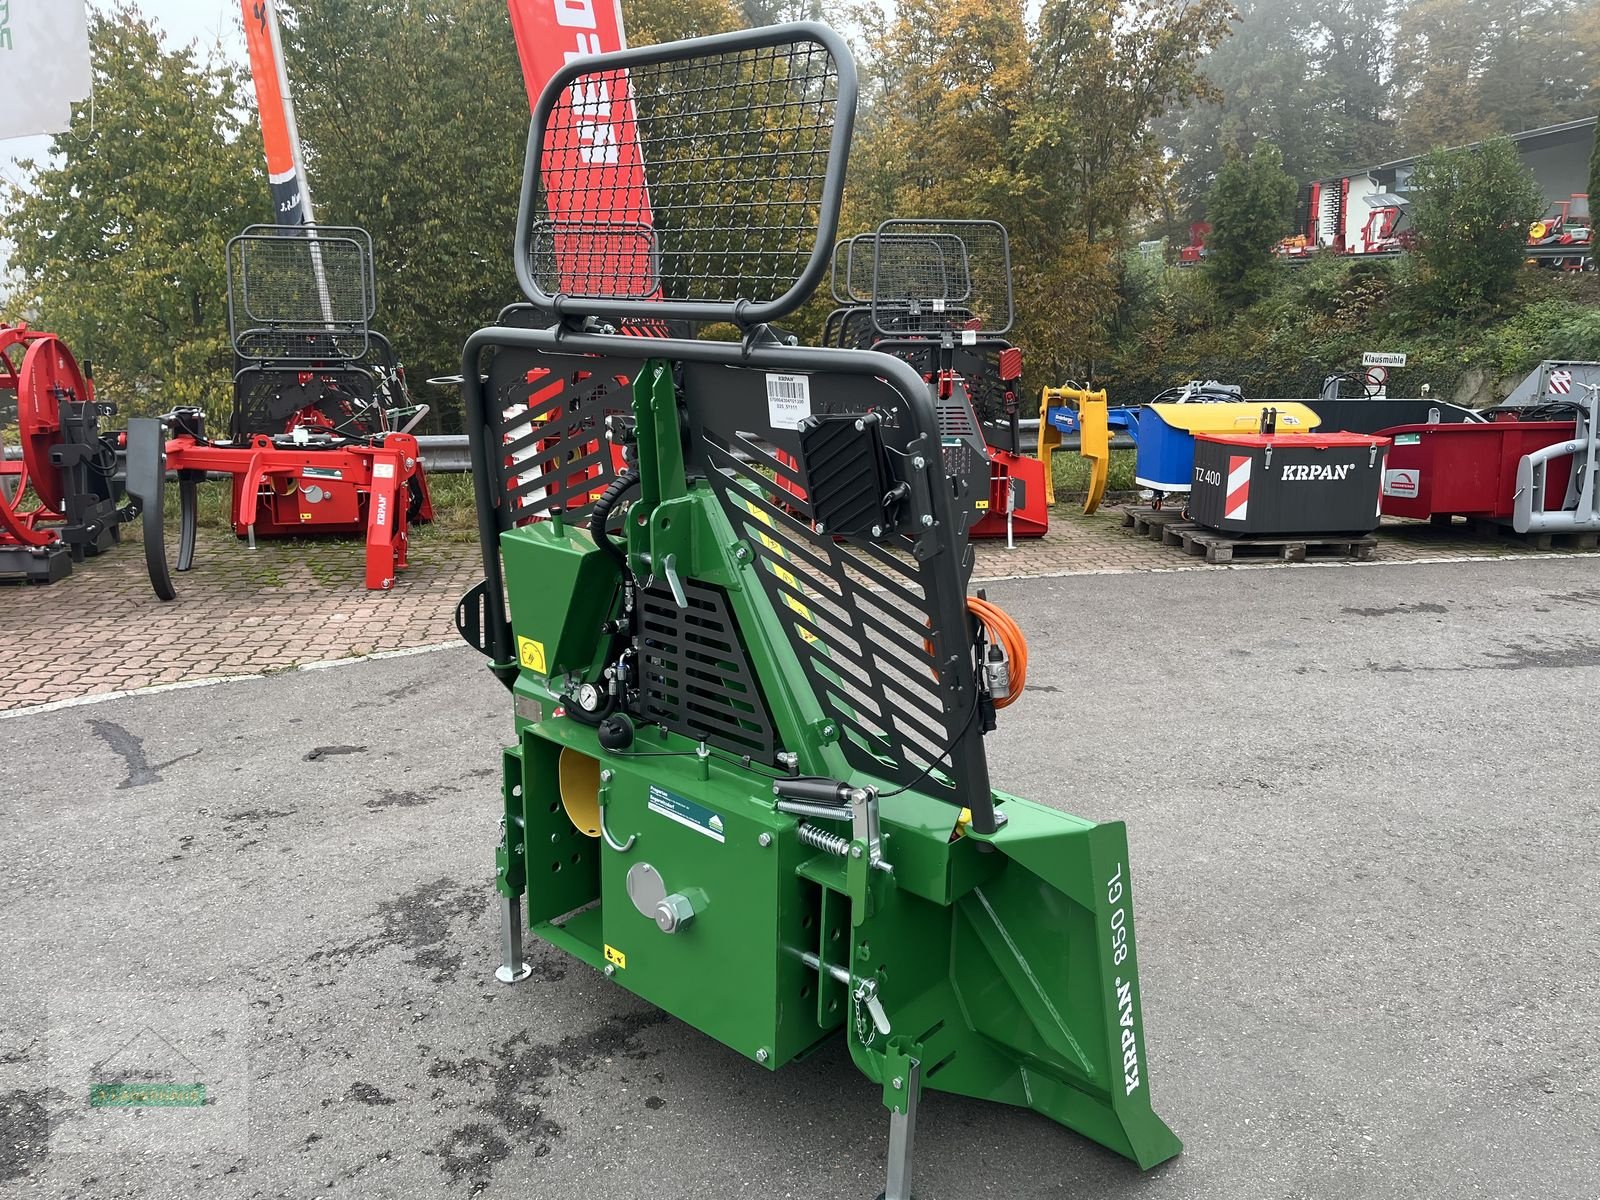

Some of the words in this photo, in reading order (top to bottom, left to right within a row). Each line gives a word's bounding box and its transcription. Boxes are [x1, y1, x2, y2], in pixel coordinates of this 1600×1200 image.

[1364, 354, 1404, 364] Klausmühle
[1195, 467, 1204, 482] TZ
[1205, 471, 1221, 487] 400
[1107, 862, 1123, 904] GL
[1110, 908, 1128, 966] 850
